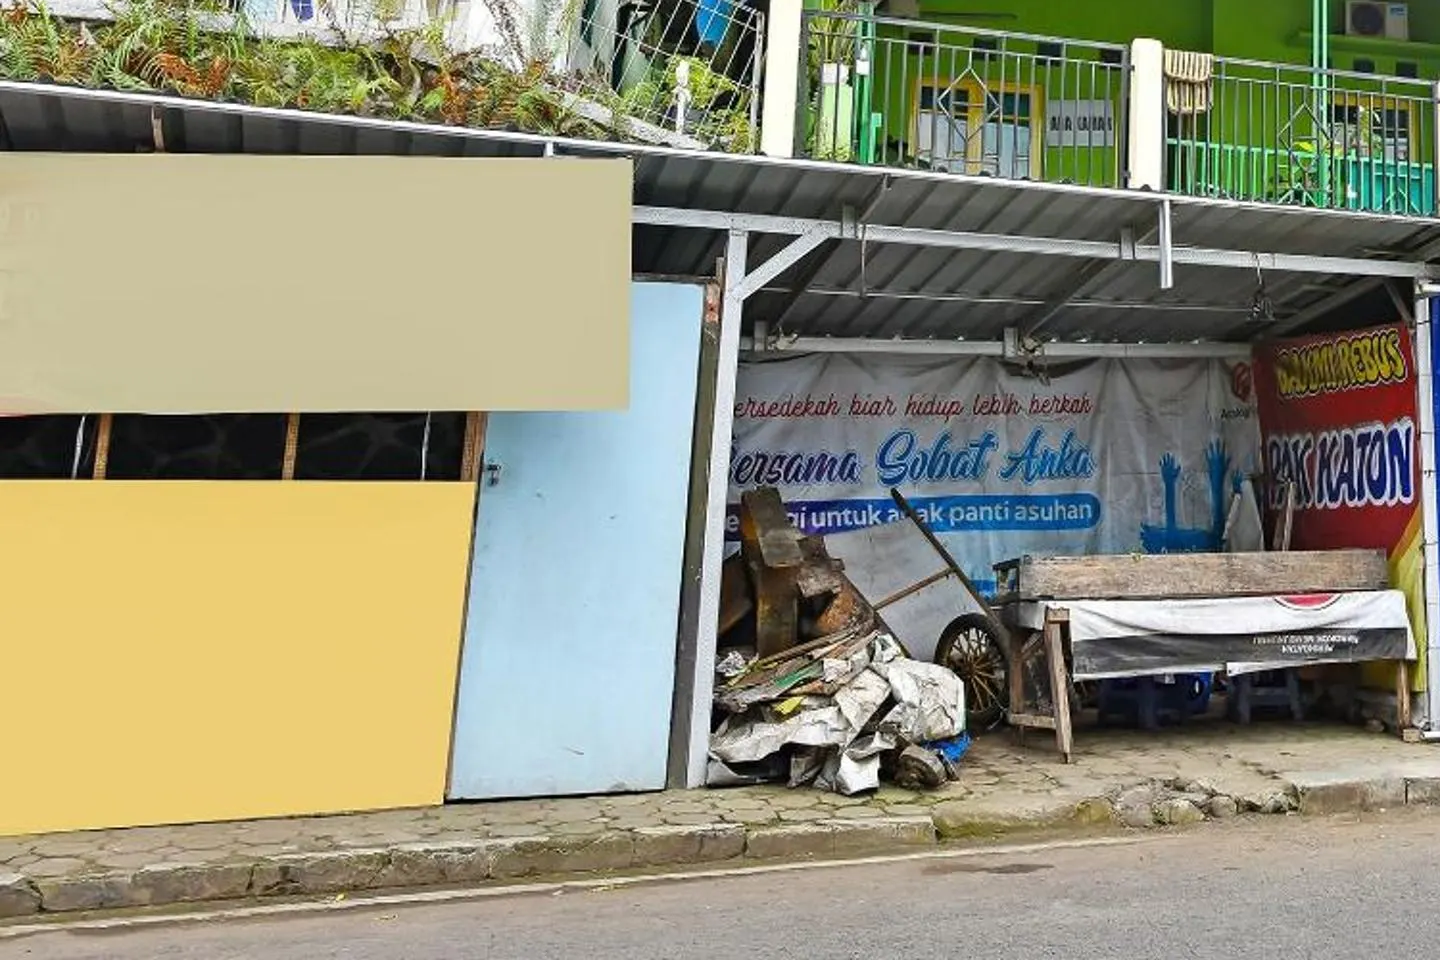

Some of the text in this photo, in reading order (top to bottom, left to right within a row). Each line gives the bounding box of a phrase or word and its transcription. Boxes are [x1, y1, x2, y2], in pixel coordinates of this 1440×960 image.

[734, 393, 840, 419] ersedekah
[849, 393, 895, 417] biar
[905, 392, 963, 424] hidup
[972, 392, 1022, 417] lebih
[730, 427, 1096, 486] ersama Sobat Anka
[1316, 422, 1413, 506] KATON
[811, 504, 882, 529] untuk
[887, 502, 943, 523] aak
[950, 501, 1009, 528] panti
[1014, 500, 1093, 522] asuhan
